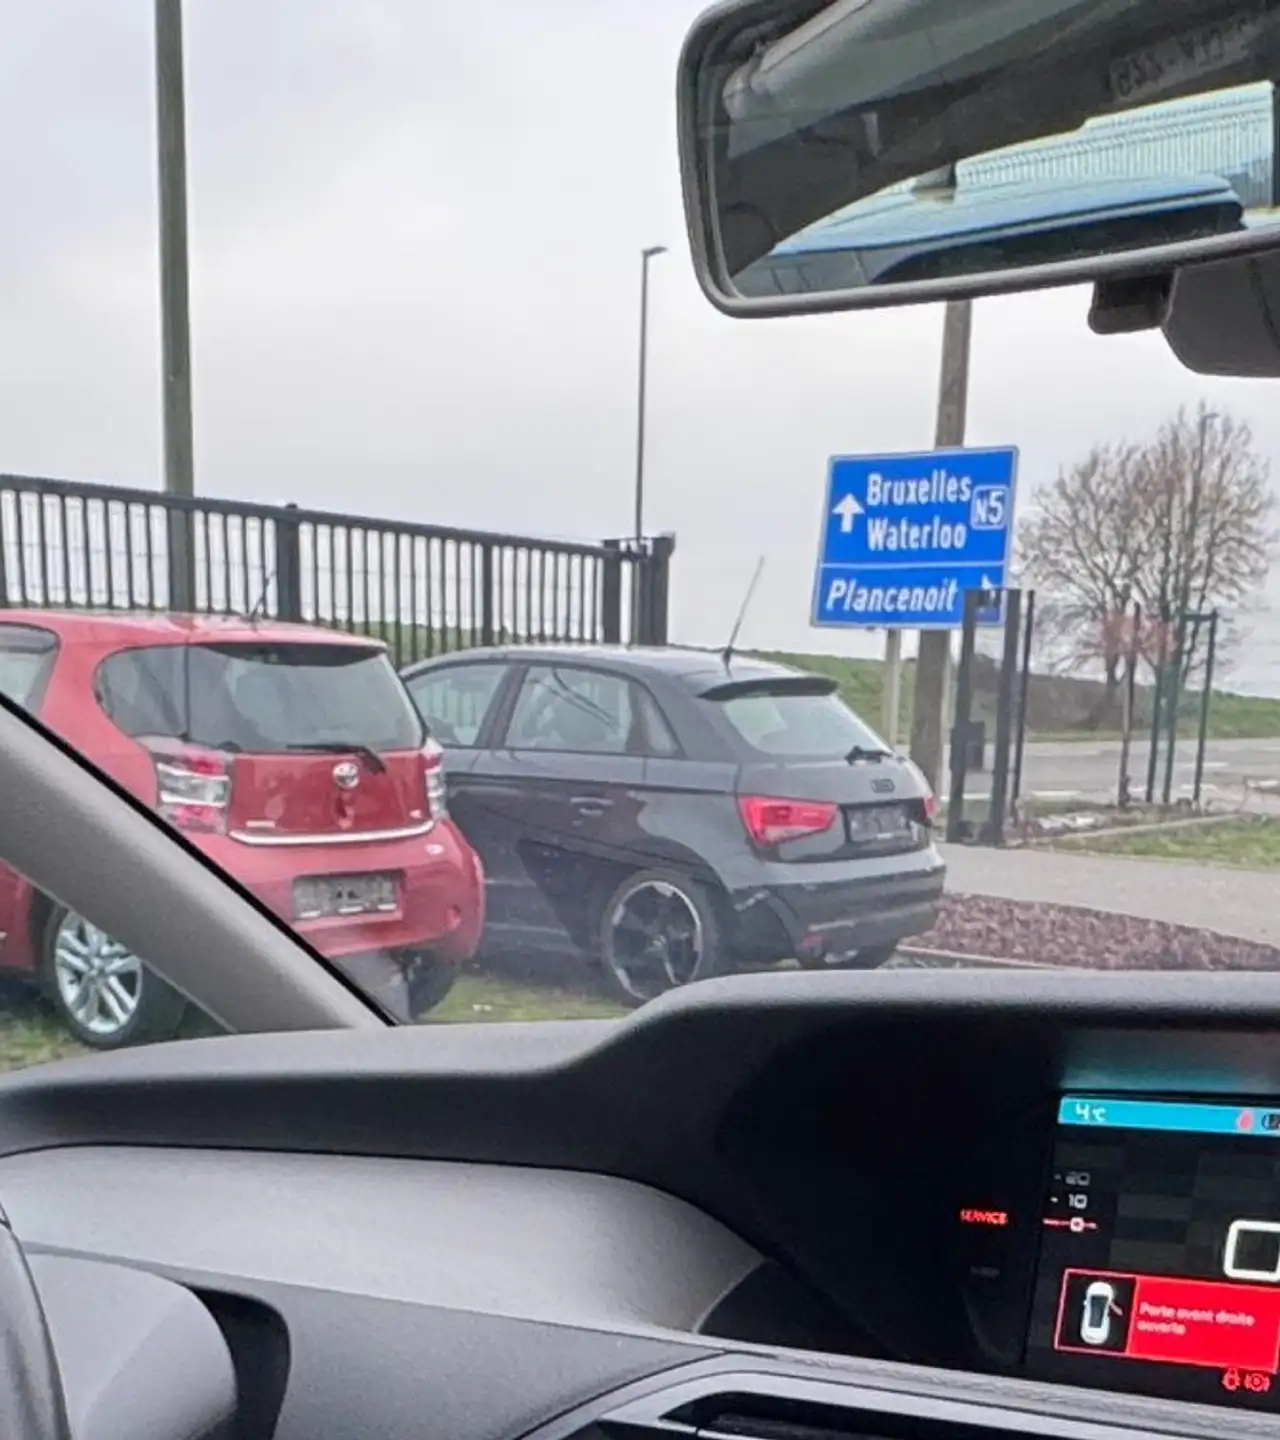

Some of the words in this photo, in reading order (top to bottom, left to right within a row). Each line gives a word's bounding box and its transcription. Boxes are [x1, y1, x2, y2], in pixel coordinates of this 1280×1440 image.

[867, 469, 972, 506] Bruxelles
[976, 491, 1005, 524] N5
[867, 516, 967, 551] Waterloo
[826, 577, 959, 612] Plancenoit
[1139, 1301, 1176, 1319] Porte
